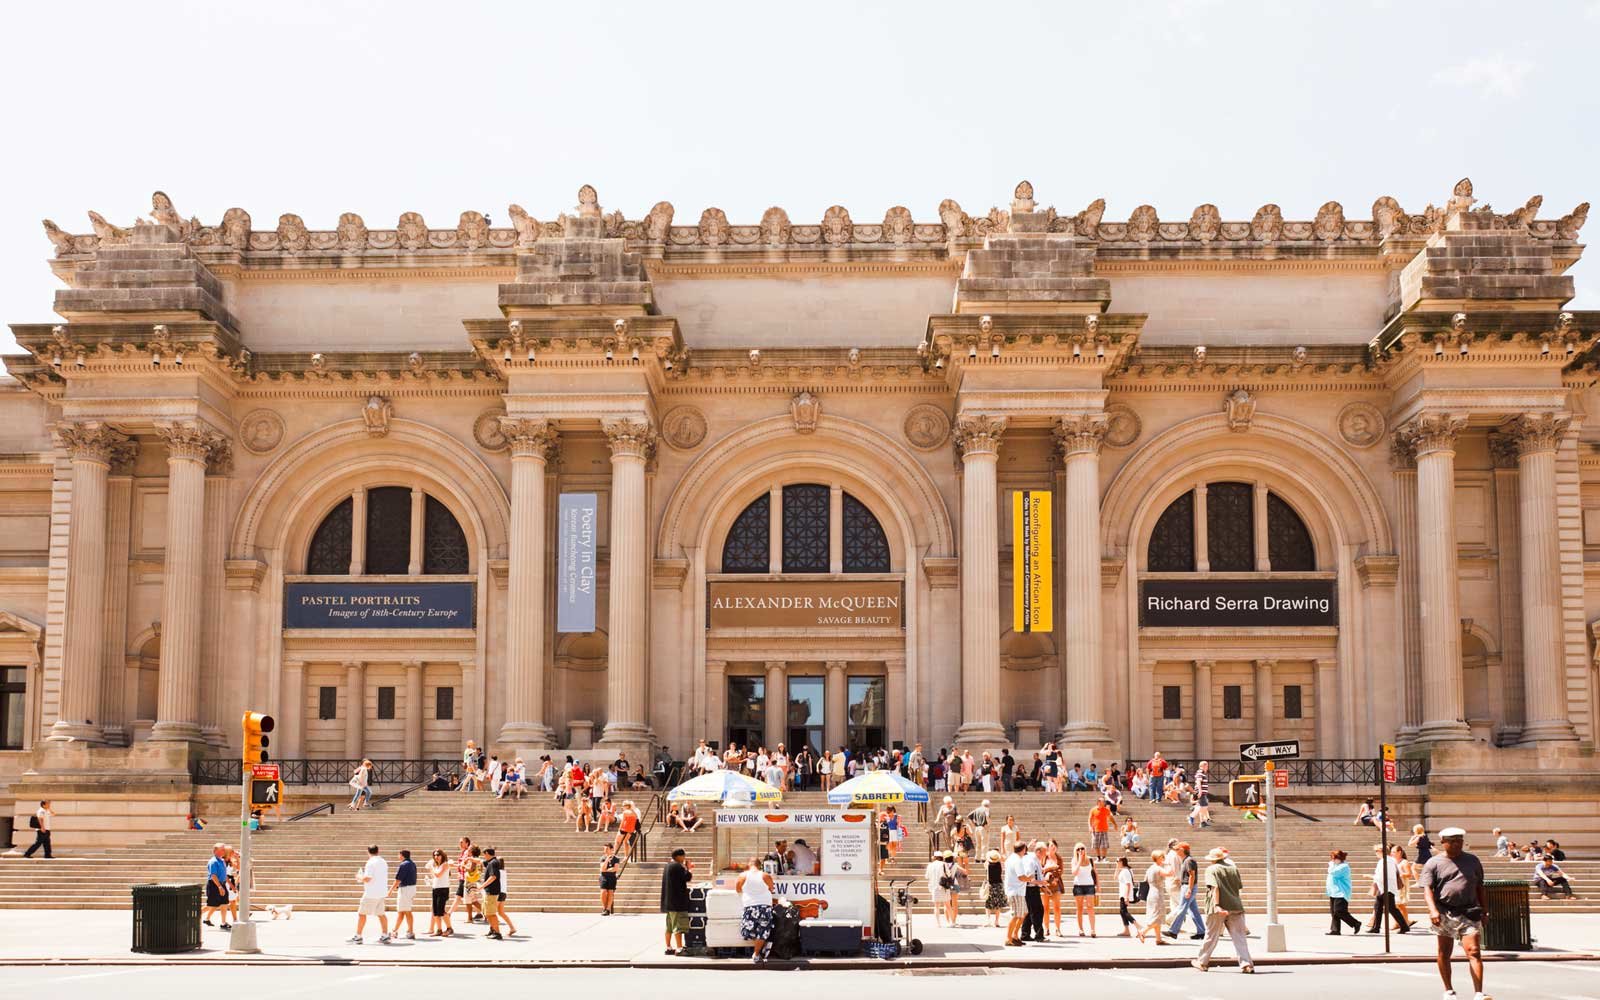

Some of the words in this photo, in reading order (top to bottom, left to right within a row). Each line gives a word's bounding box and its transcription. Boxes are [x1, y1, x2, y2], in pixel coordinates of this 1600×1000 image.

[578, 508, 594, 548] Poetry
[1032, 498, 1041, 557] Reconfiguring
[581, 551, 593, 562] in
[1033, 560, 1040, 570] an
[578, 566, 594, 594] Clay
[1033, 574, 1041, 604] African
[302, 596, 347, 605] PASTEL
[350, 596, 420, 605] PORTRAITS
[713, 597, 814, 609] ALEXANDER
[818, 596, 898, 612] McQUEEN
[1148, 596, 1210, 610] Richard
[1215, 596, 1258, 610] Serra
[1264, 596, 1329, 612] Drawing
[328, 608, 358, 618] Images
[360, 608, 370, 618] of
[372, 608, 426, 618] 18th-Century
[428, 608, 458, 618] Europe
[1248, 748, 1264, 756] ONE
[1274, 746, 1292, 754] WAY
[855, 792, 901, 800] SABRETT
[772, 883, 788, 894] EW
[793, 883, 826, 895] YORK
